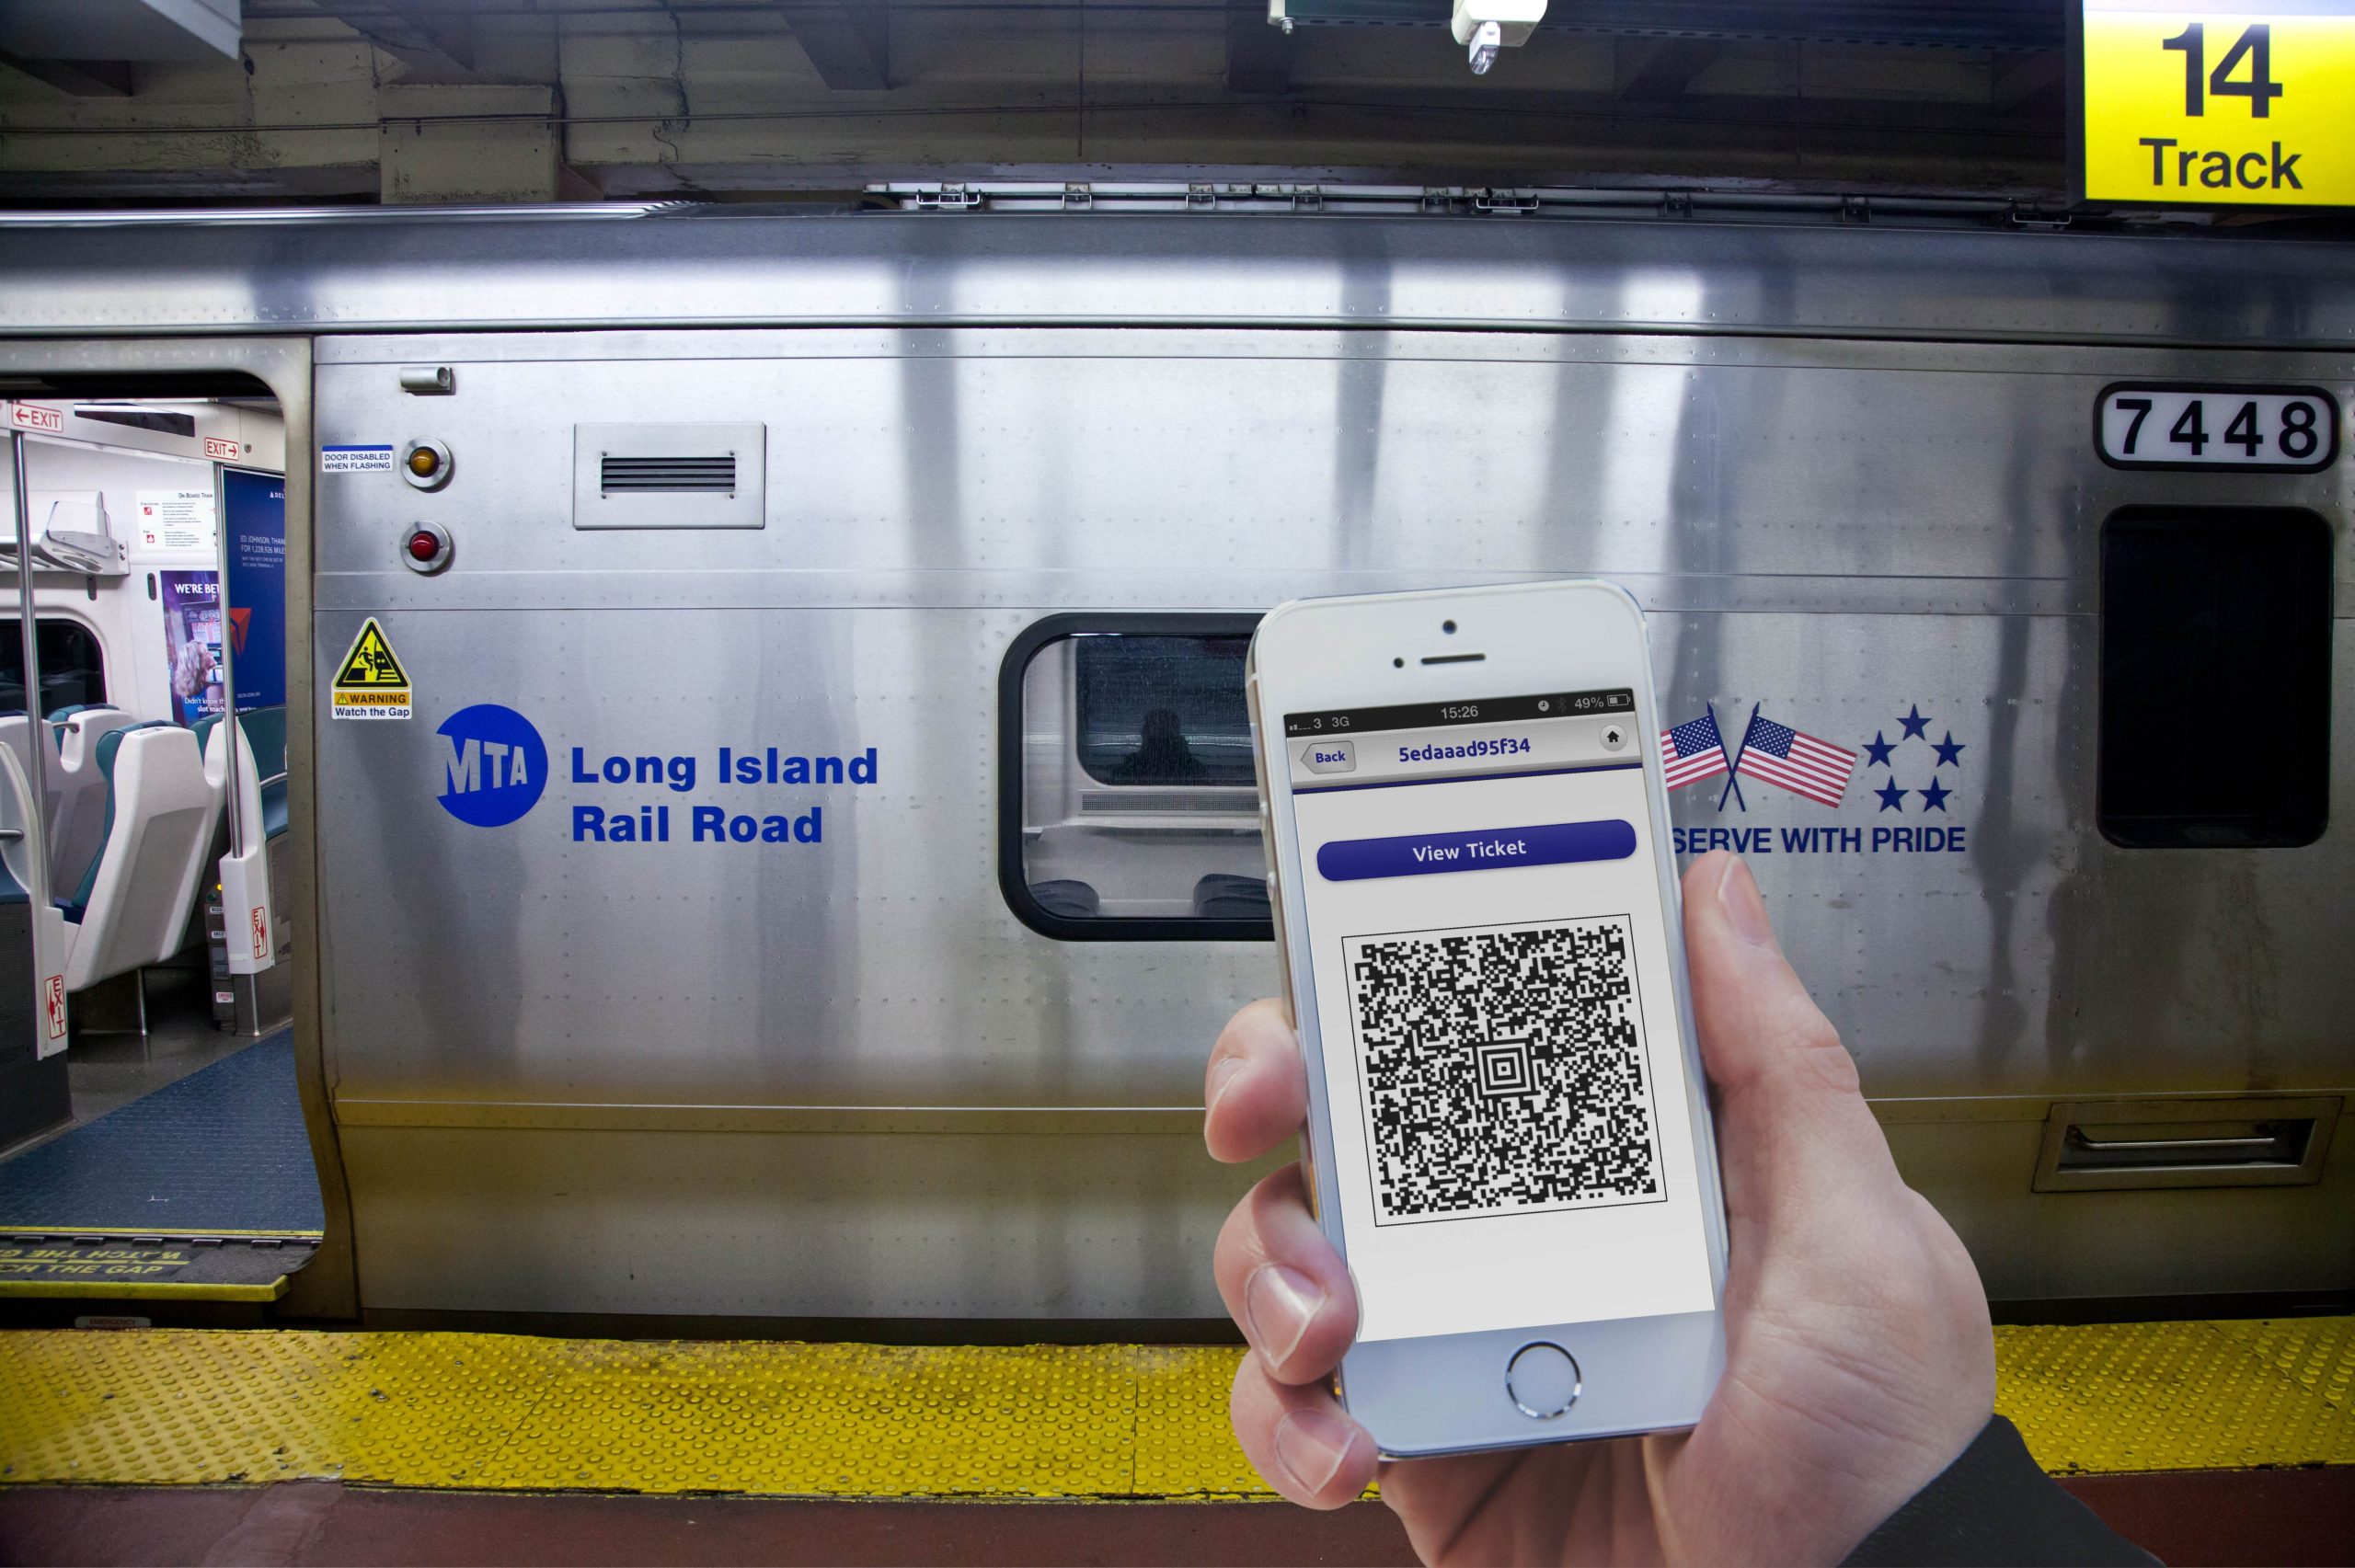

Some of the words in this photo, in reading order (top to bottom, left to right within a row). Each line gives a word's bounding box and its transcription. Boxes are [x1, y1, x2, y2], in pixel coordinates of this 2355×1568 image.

[2163, 22, 2282, 119] 14
[2139, 137, 2303, 189] Track
[31, 409, 60, 429] EXIT
[2116, 398, 2318, 458] 7448
[207, 441, 227, 456] EXIT
[350, 462, 390, 470] FLASHING
[175, 583, 203, 594] WE'RE
[335, 707, 367, 716] Watch
[370, 707, 386, 716] the
[388, 707, 410, 717] Gap
[350, 694, 407, 704] WARNING
[1314, 717, 1322, 729] 3
[1332, 716, 1350, 727] 3G
[1441, 705, 1479, 720] 15:26
[1574, 696, 1604, 710] 49%
[1315, 750, 1346, 763] Back
[1398, 737, 1531, 762] 5edaaad95f34
[444, 737, 528, 796] MTA
[571, 747, 695, 793] Long
[718, 747, 878, 784] Island
[572, 806, 669, 842] Rail
[692, 806, 822, 843] Road
[1412, 844, 1460, 863] View
[1466, 839, 1527, 859] Ticket
[1672, 828, 1772, 854] SERVE
[1781, 827, 1861, 853] WITH
[1872, 826, 1966, 853] PRIDE
[253, 910, 261, 956] EXIT
[53, 978, 63, 1033] EXIT
[47, 1265, 101, 1274] THE
[106, 1265, 164, 1275] GAP
